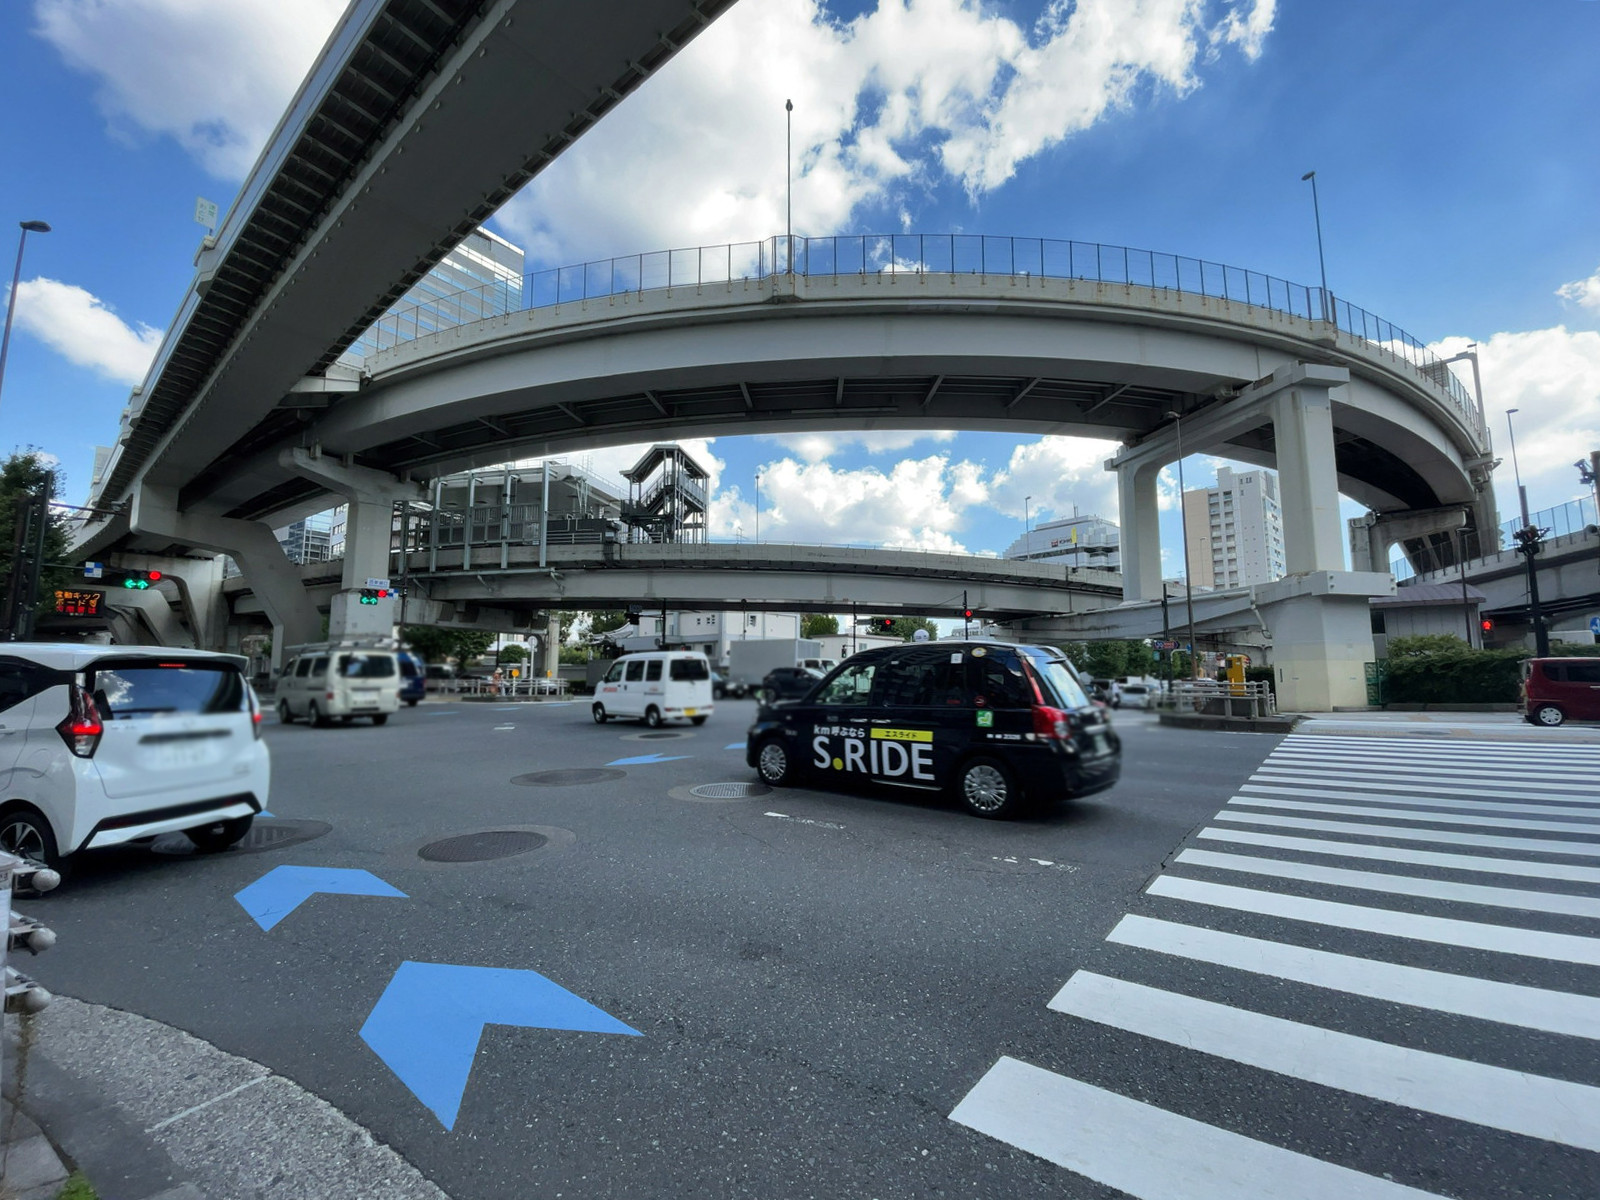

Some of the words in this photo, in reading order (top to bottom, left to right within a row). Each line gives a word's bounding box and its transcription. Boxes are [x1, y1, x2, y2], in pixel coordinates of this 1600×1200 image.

[884, 730, 918, 739] エスライド
[812, 735, 936, 781] S.RIDE
